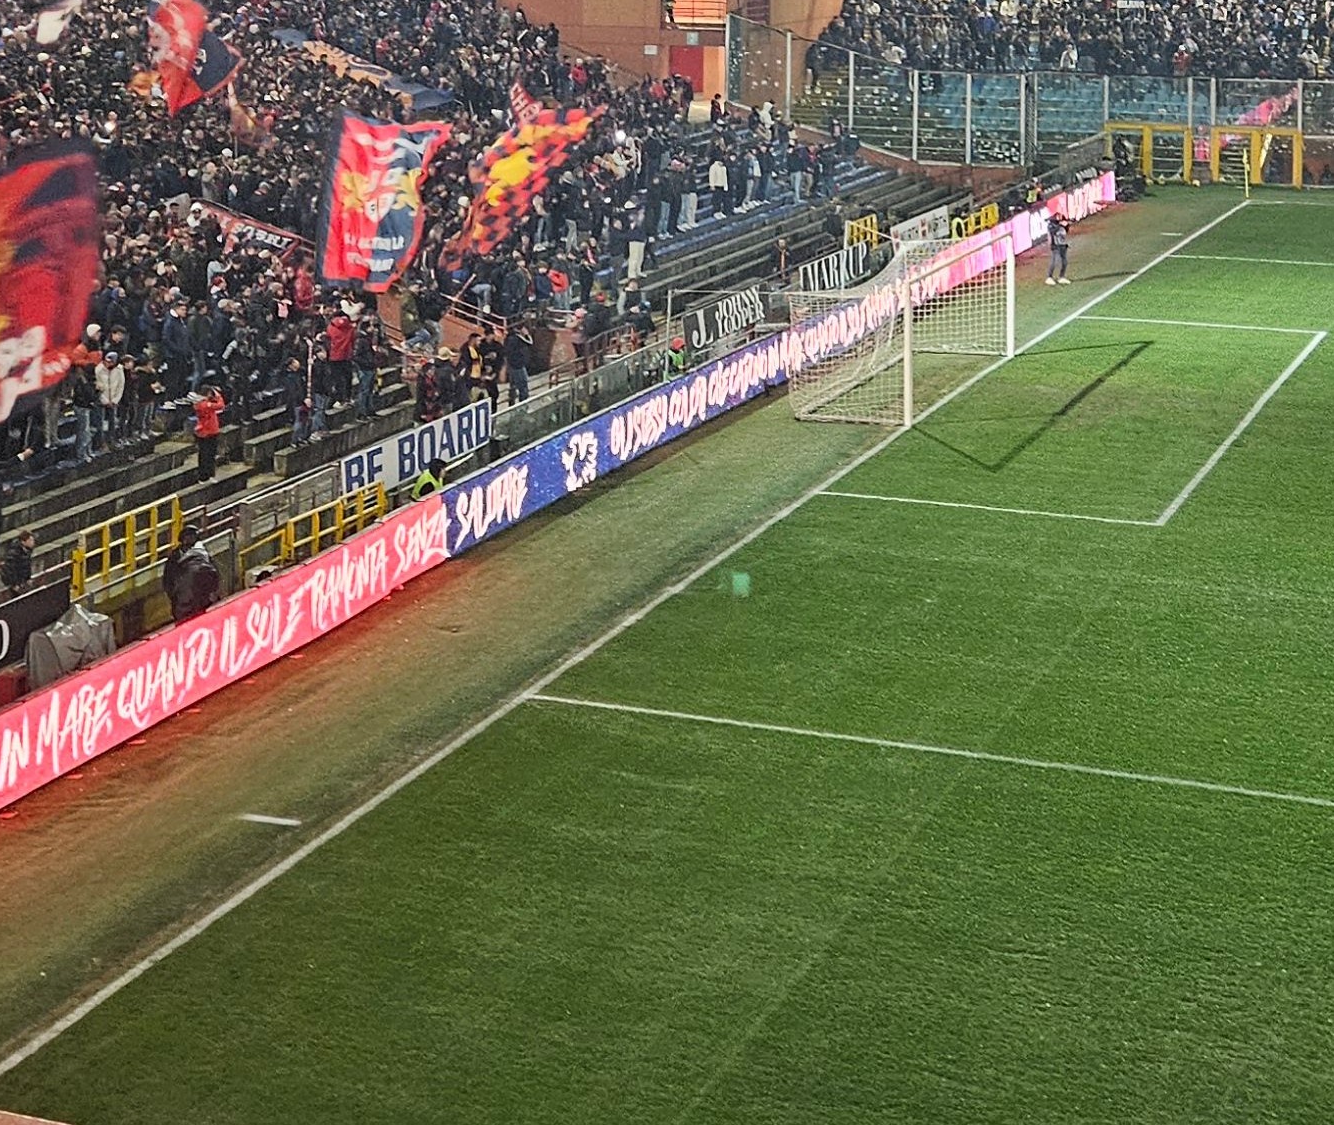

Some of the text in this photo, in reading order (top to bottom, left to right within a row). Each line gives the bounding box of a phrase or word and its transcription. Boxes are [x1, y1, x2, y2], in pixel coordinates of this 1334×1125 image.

[397, 401, 490, 482] BOARD
[219, 615, 251, 677] IL
[244, 586, 305, 668] SOLE
[392, 511, 453, 582] SENZA
